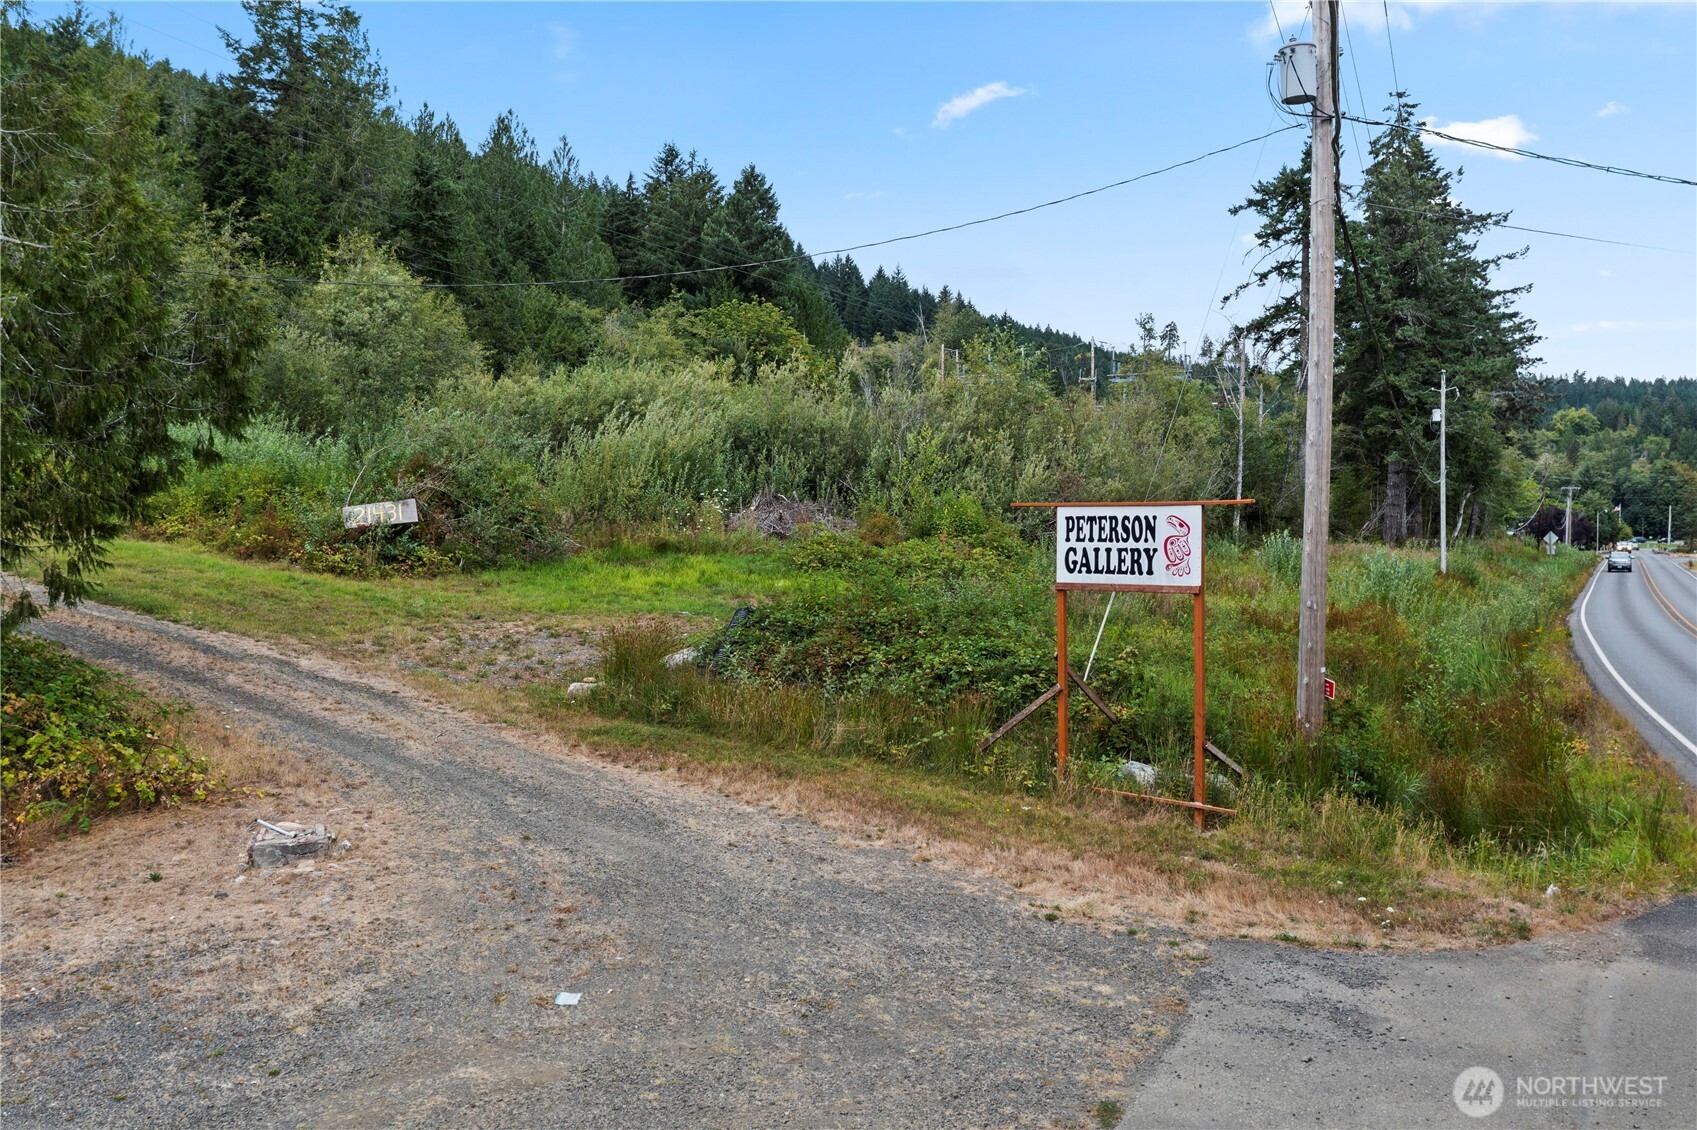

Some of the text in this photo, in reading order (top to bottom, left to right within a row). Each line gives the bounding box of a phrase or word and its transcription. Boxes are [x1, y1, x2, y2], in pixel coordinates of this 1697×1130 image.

[353, 503, 403, 526] 21431
[1064, 515, 1157, 543] PETERSON
[1064, 546, 1158, 576] GALLERY
